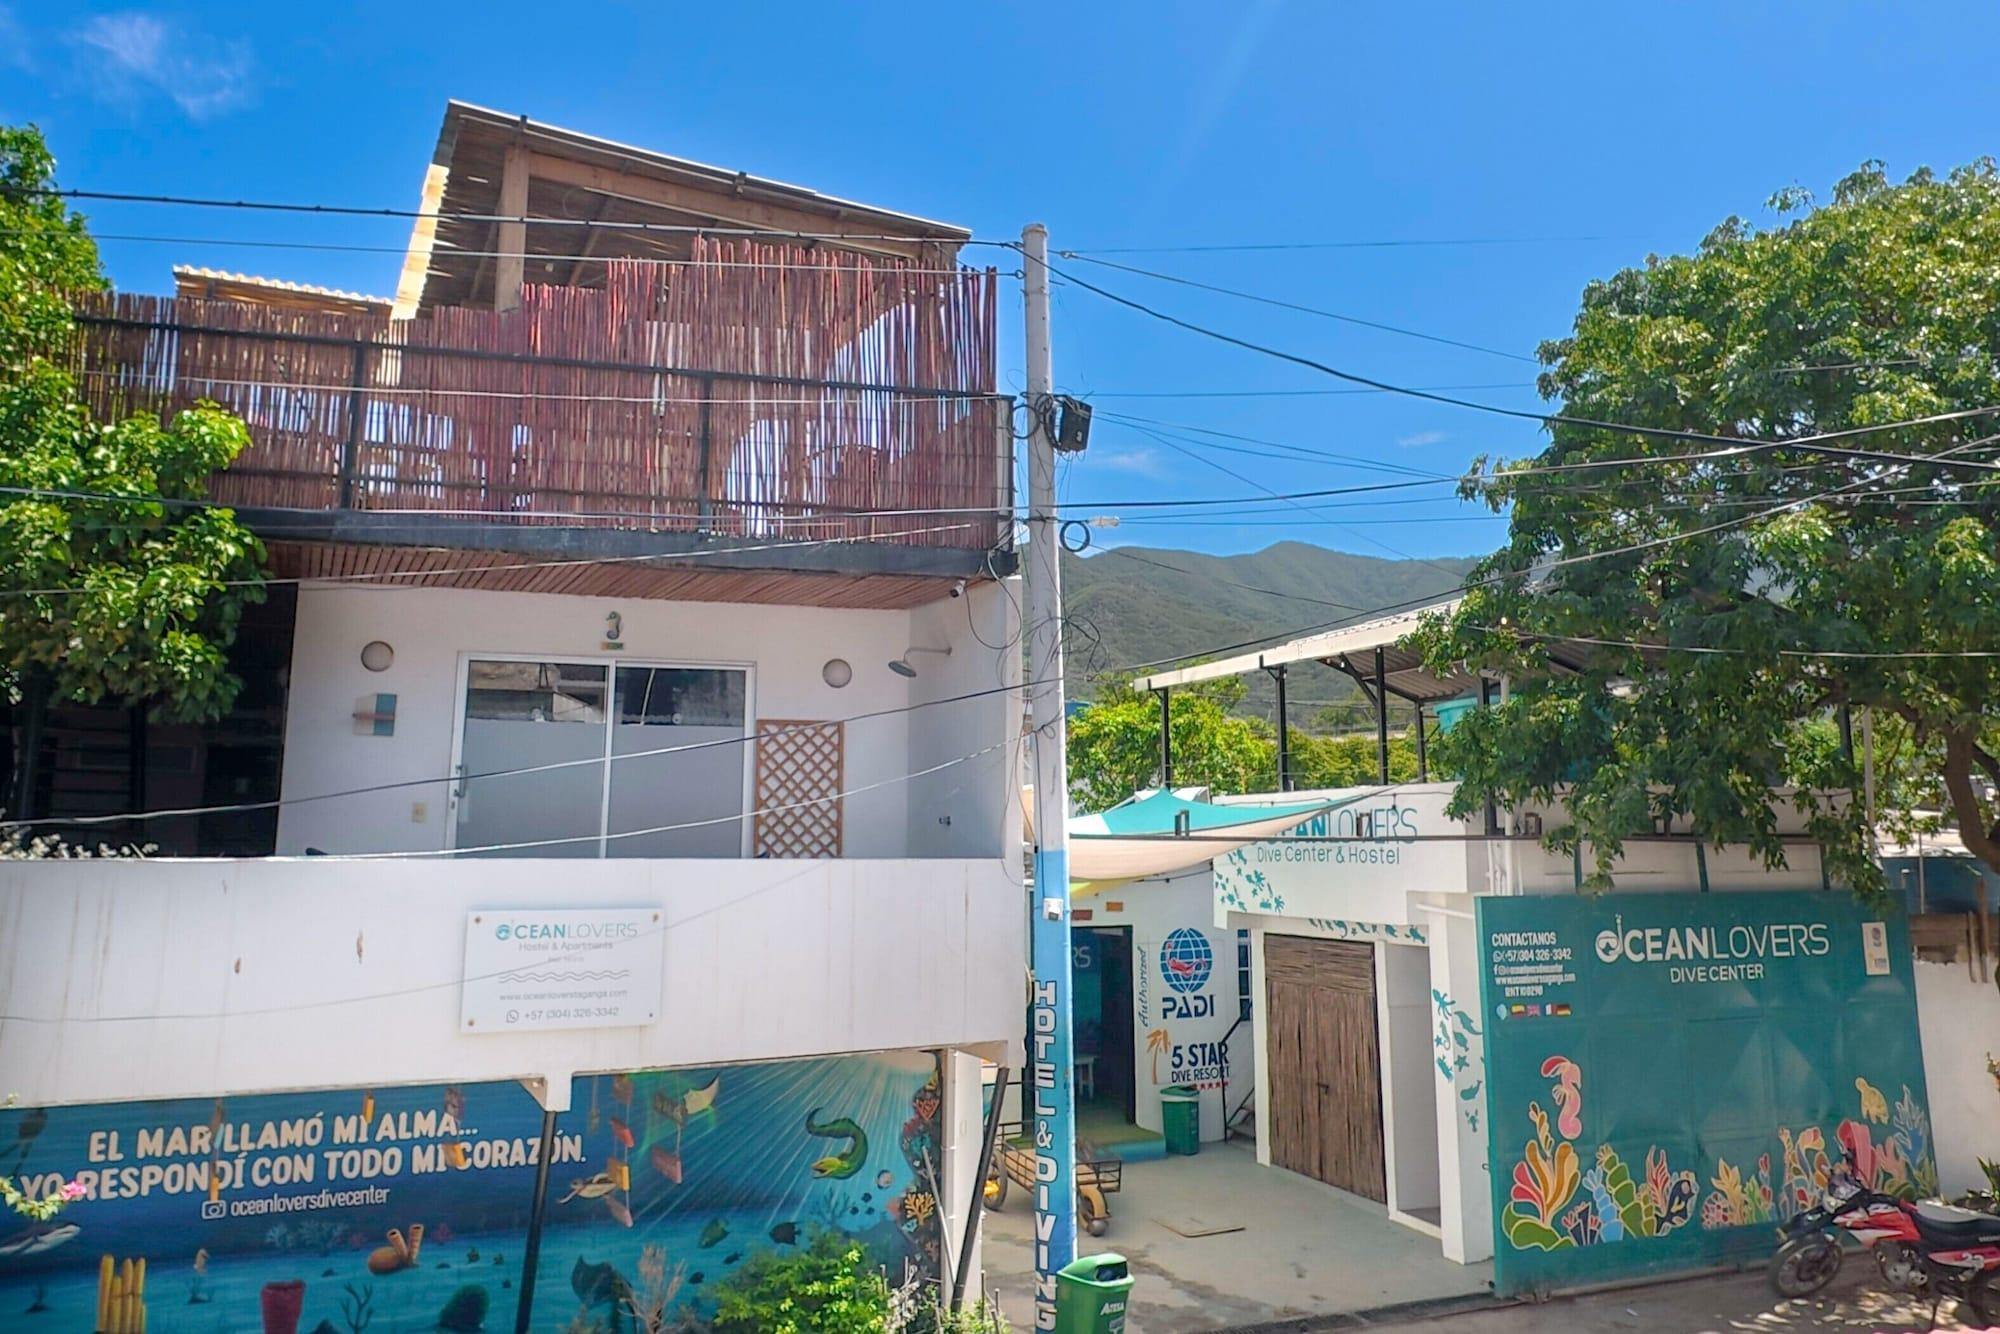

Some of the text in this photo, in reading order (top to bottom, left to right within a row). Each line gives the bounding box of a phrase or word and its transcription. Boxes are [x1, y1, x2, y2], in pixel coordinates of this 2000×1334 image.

[1257, 846, 1400, 865] Dive Center & Hostel
[495, 923, 639, 941] OCEANLOVERS
[1492, 932, 1557, 946] CONTACTANOS
[1670, 964, 1764, 983] DIVE CENTER
[525, 1010, 543, 1020] +57
[546, 1008, 571, 1020] (304)
[1162, 995, 1215, 1019] PADI
[1171, 1042, 1229, 1068] 5 STAR
[1171, 1069, 1191, 1083] DIVE
[88, 1109, 479, 1163] EL MAR LLAMÓ MI ALMA...
[1034, 980, 1058, 1332] HOTEL & DIVING
[20, 1171, 65, 1200] YO
[75, 1152, 248, 1201] RESPONDÍ
[251, 1152, 315, 1188] CON
[324, 1146, 402, 1180] TODO
[411, 1144, 447, 1174] MI
[230, 1185, 391, 1217] oceanloversdivecenter
